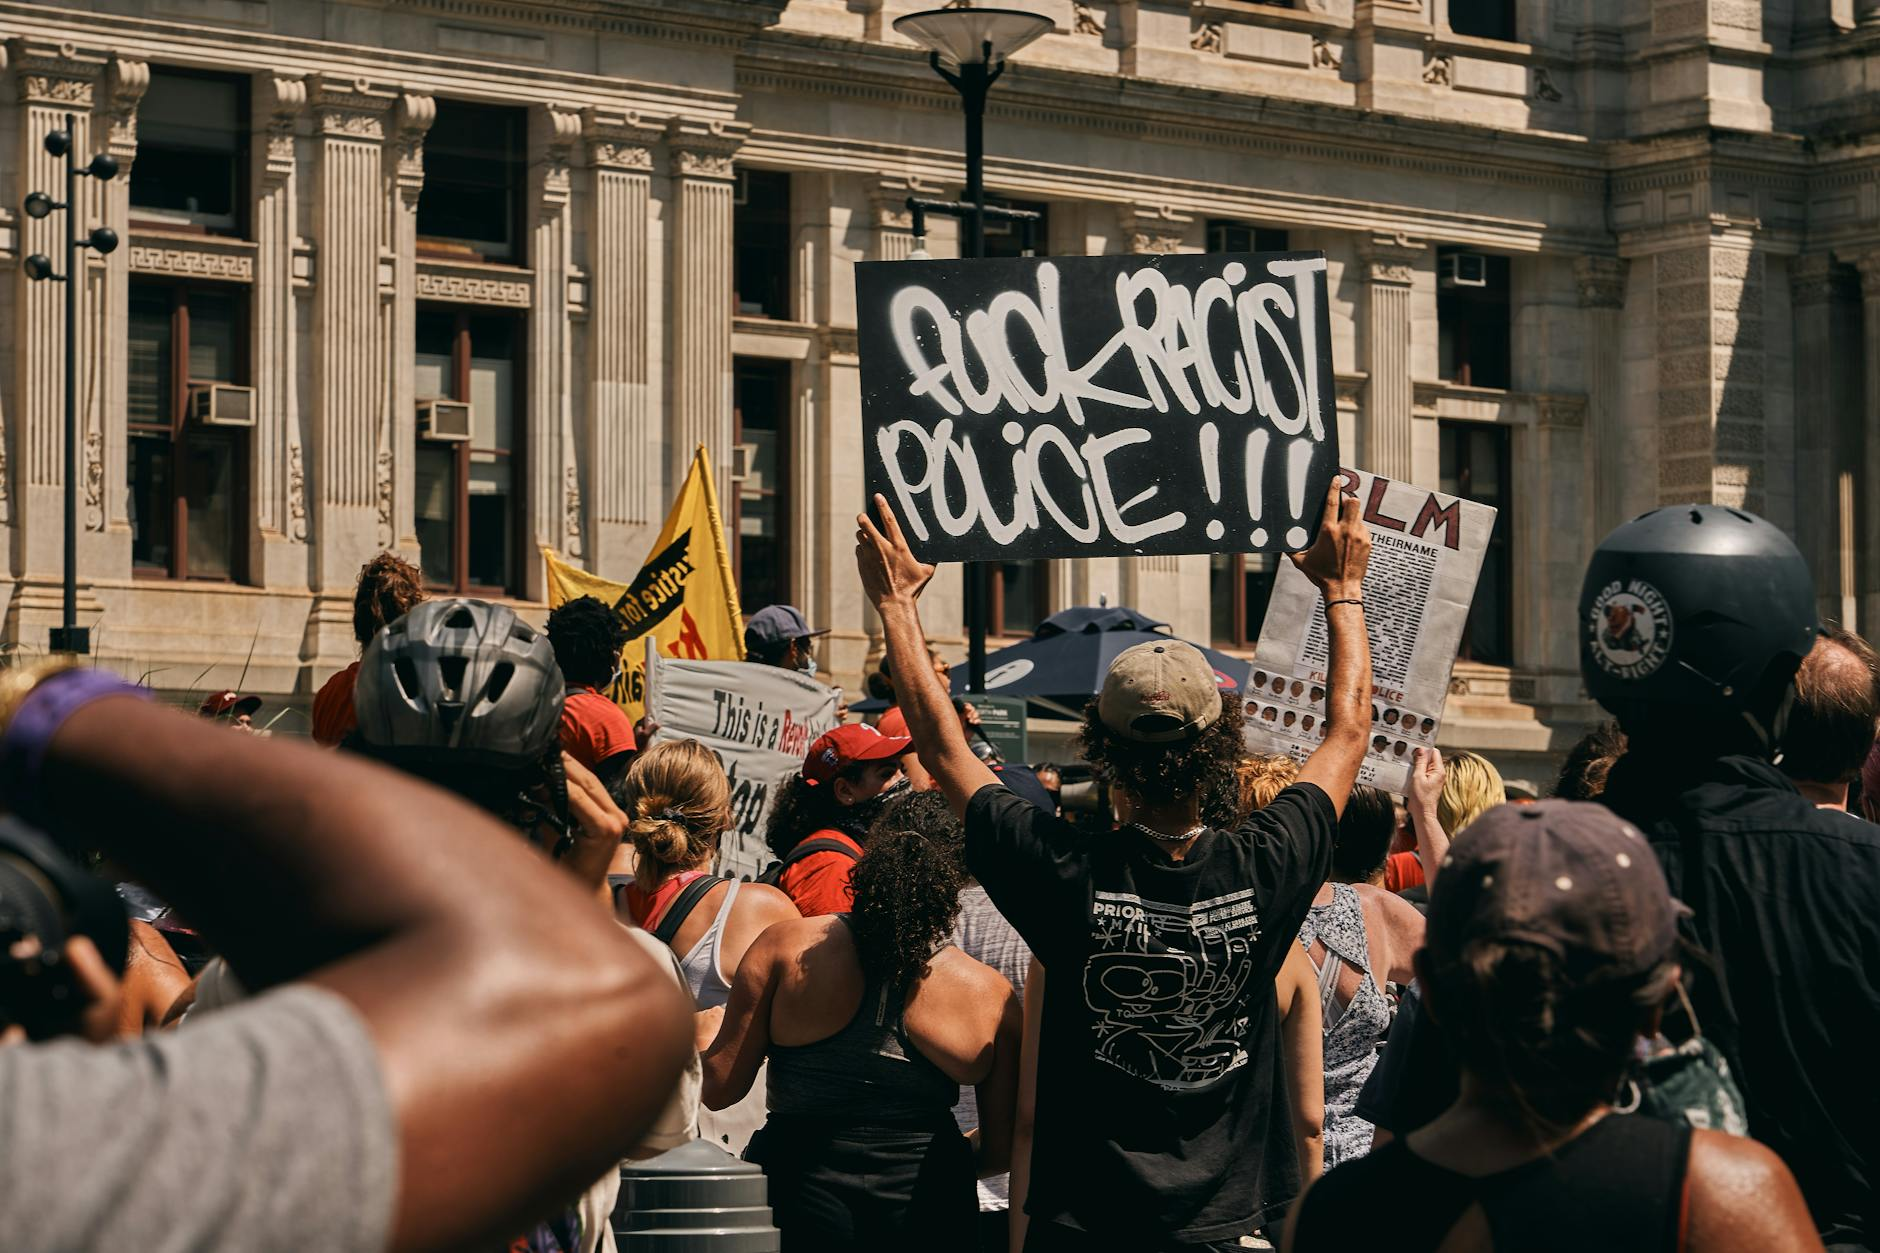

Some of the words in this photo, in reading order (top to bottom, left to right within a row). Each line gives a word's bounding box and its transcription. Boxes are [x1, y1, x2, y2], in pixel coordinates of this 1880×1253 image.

[712, 689, 751, 743] This
[751, 702, 768, 748] is
[768, 718, 779, 750] a
[1371, 686, 1404, 702] OLICE
[712, 750, 767, 851] top
